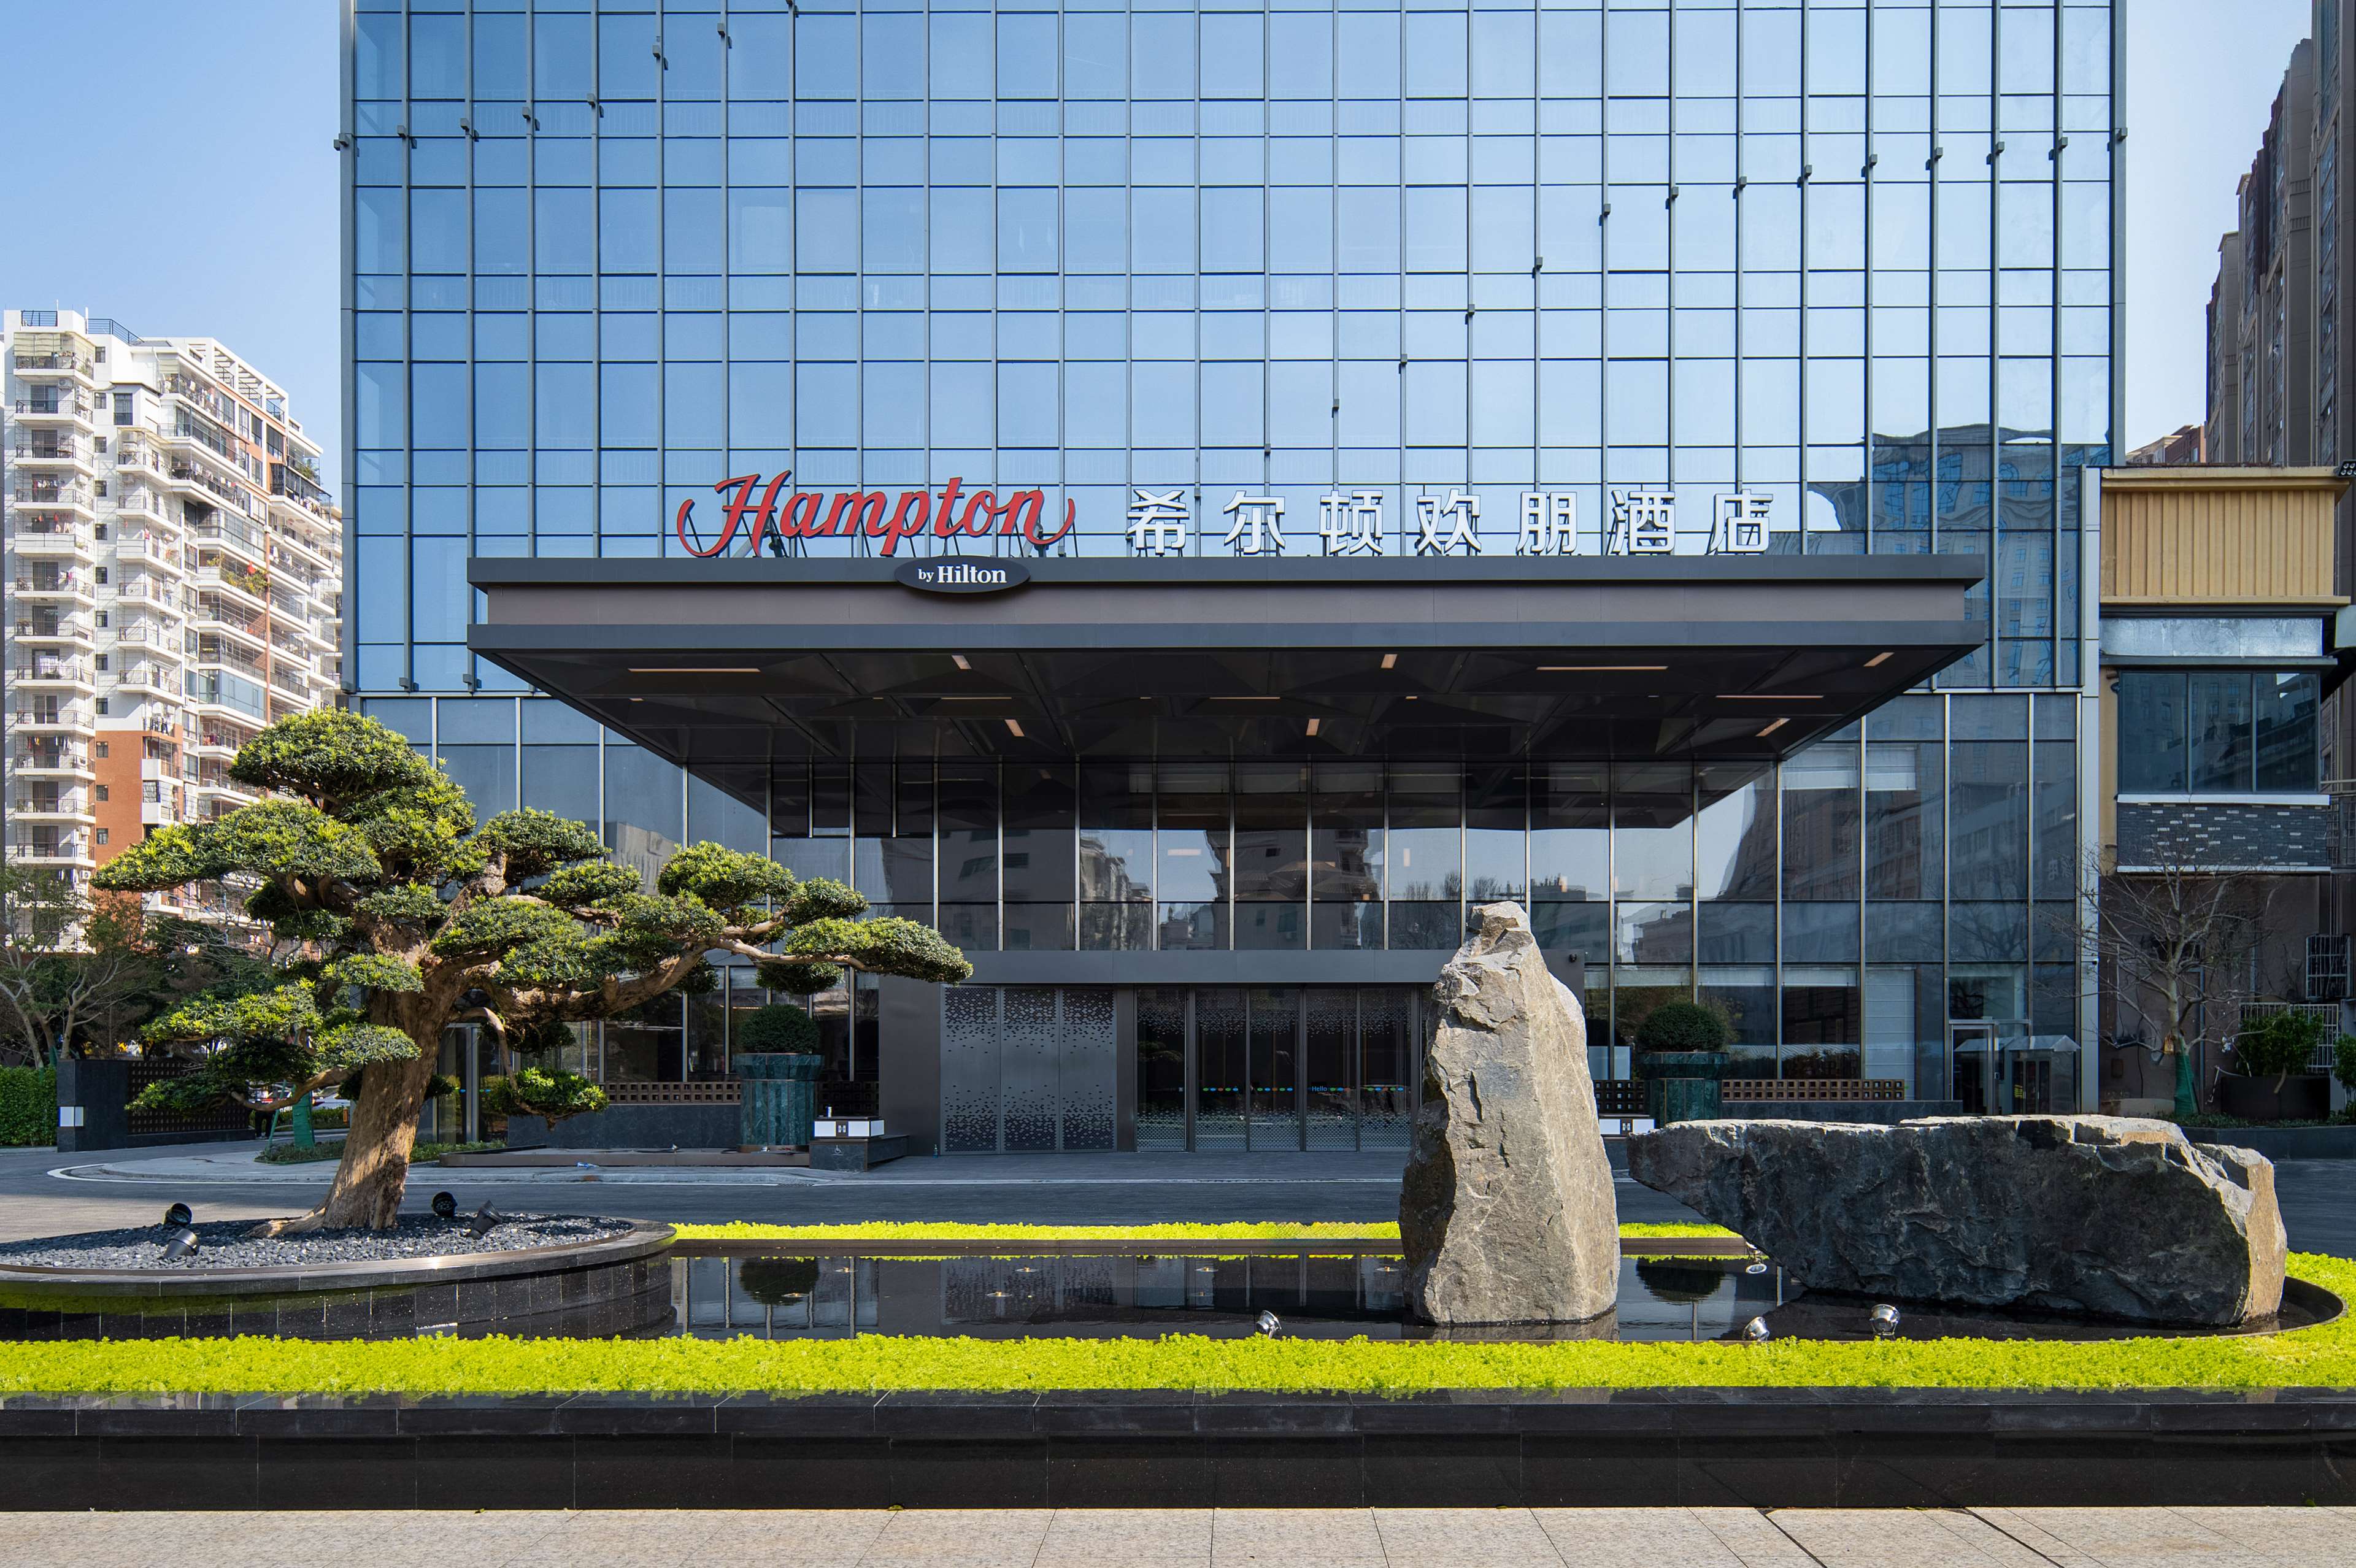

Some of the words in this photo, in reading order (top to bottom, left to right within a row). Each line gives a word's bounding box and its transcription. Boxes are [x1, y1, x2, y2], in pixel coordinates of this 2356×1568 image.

[677, 470, 1076, 557] Hampton
[1126, 489, 1774, 555] 希尔顿欢朋酒店
[918, 568, 934, 583] by
[937, 564, 1007, 583] Hilton
